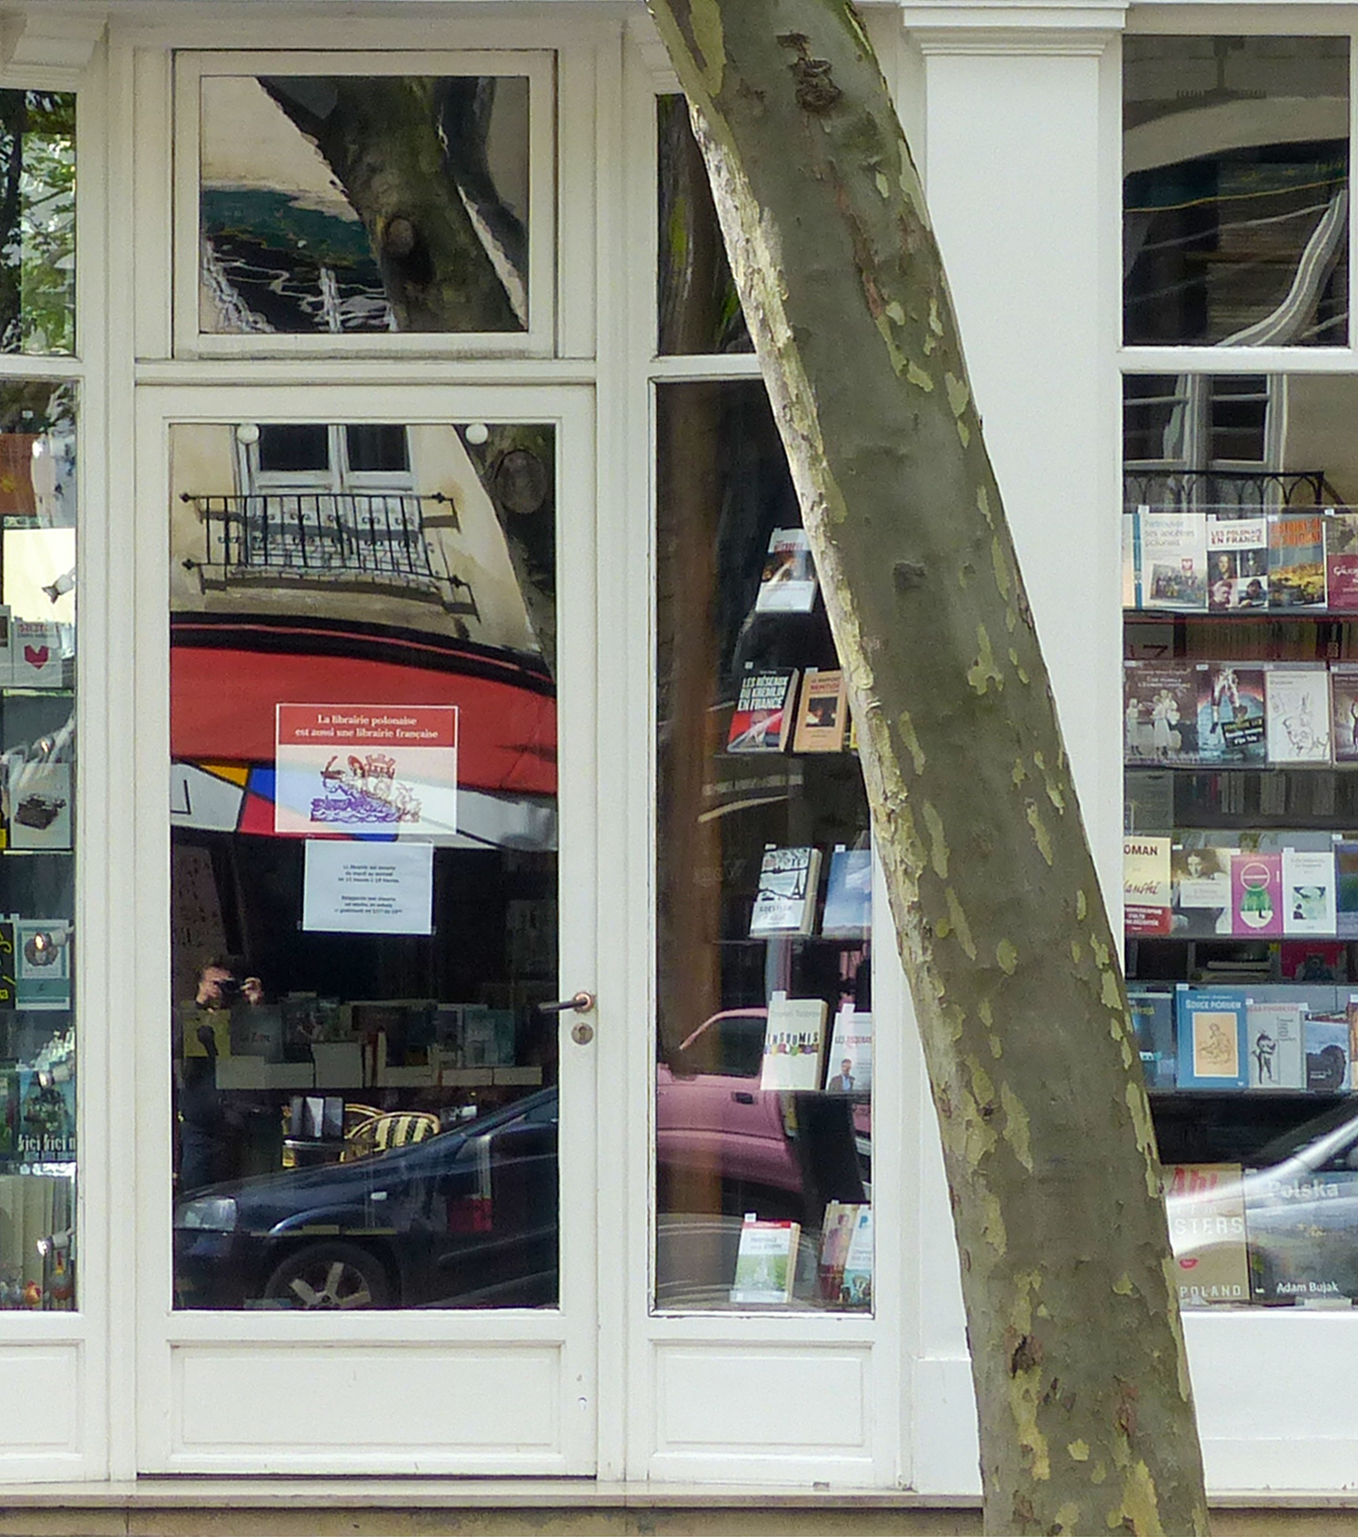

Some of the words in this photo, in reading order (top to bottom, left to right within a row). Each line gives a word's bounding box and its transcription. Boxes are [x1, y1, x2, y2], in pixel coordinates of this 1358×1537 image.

[317, 715, 331, 725] La
[332, 714, 370, 725] librairie
[371, 715, 418, 728] polonaise
[356, 727, 394, 739] librairie
[767, 1031, 819, 1047] INSOUMIS
[1180, 1285, 1242, 1298] POLAND
[1276, 1281, 1308, 1295] Adam
[1309, 1280, 1340, 1296] Bujak
